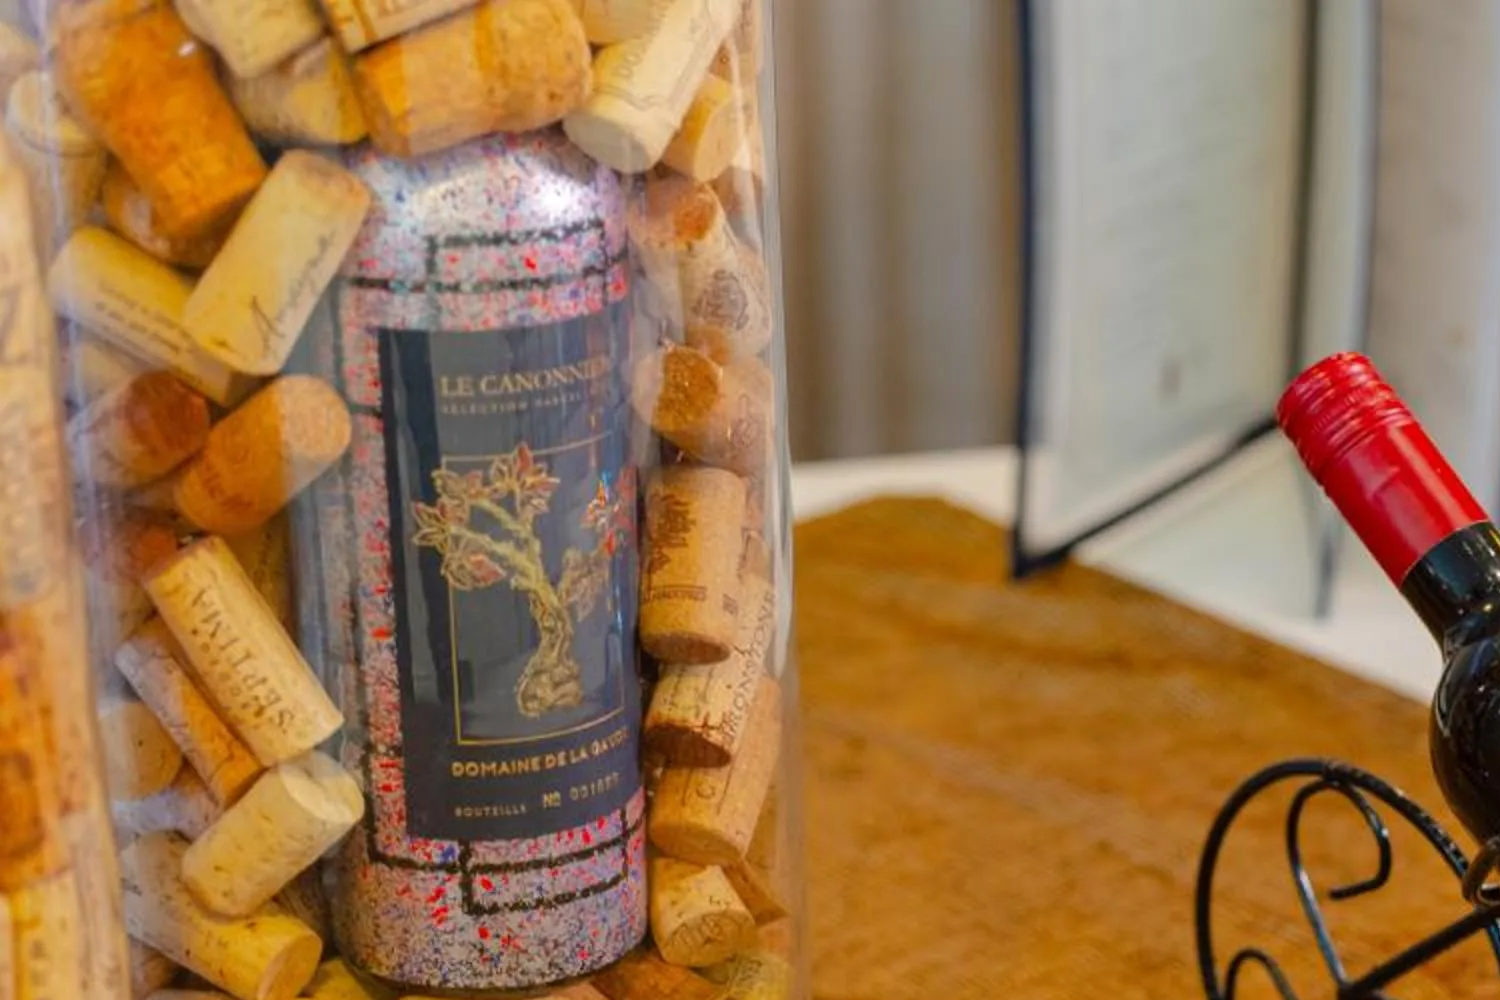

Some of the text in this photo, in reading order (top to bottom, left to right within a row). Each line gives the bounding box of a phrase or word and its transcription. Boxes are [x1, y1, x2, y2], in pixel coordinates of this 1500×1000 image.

[439, 374, 474, 398] LE
[451, 757, 542, 779] DOMAINE
[544, 750, 569, 771] DE
[570, 747, 590, 765] LA
